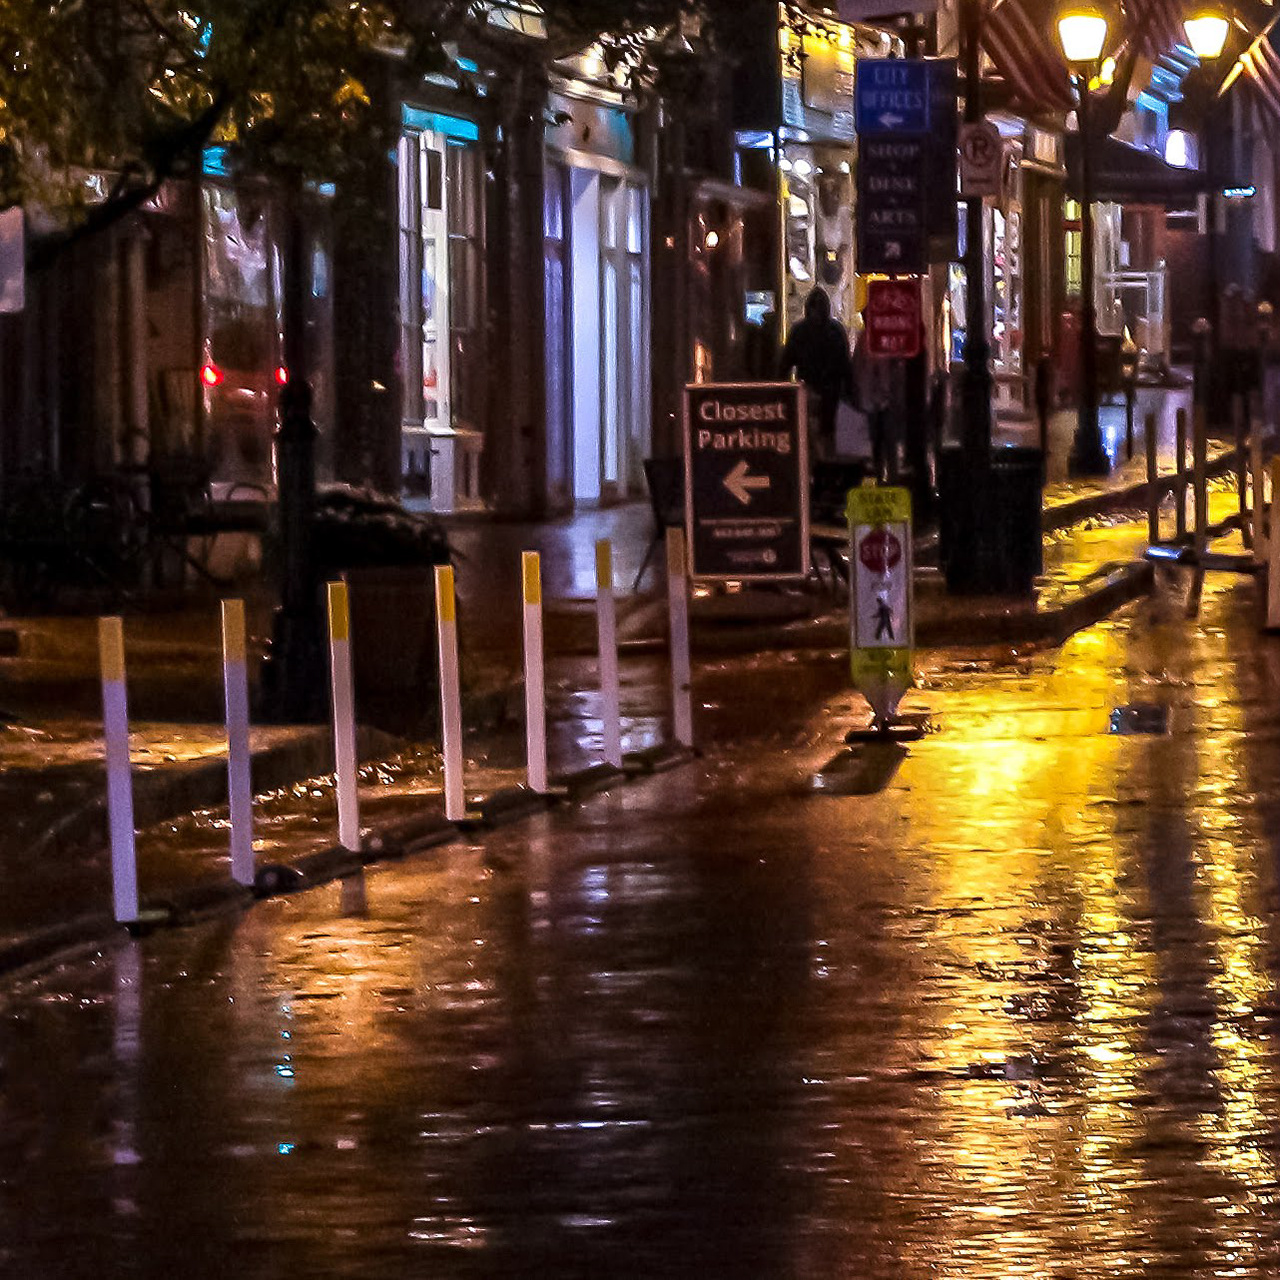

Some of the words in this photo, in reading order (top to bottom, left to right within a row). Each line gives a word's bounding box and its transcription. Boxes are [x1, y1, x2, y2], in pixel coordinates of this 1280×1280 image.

[873, 66, 908, 85] CITY
[861, 89, 923, 110] OFFICES
[867, 143, 920, 157] SHOP
[868, 175, 917, 192] DINE
[867, 209, 918, 225] ARTS
[698, 400, 787, 421] Closest
[697, 429, 792, 455] Parking
[861, 544, 899, 561] STOP
